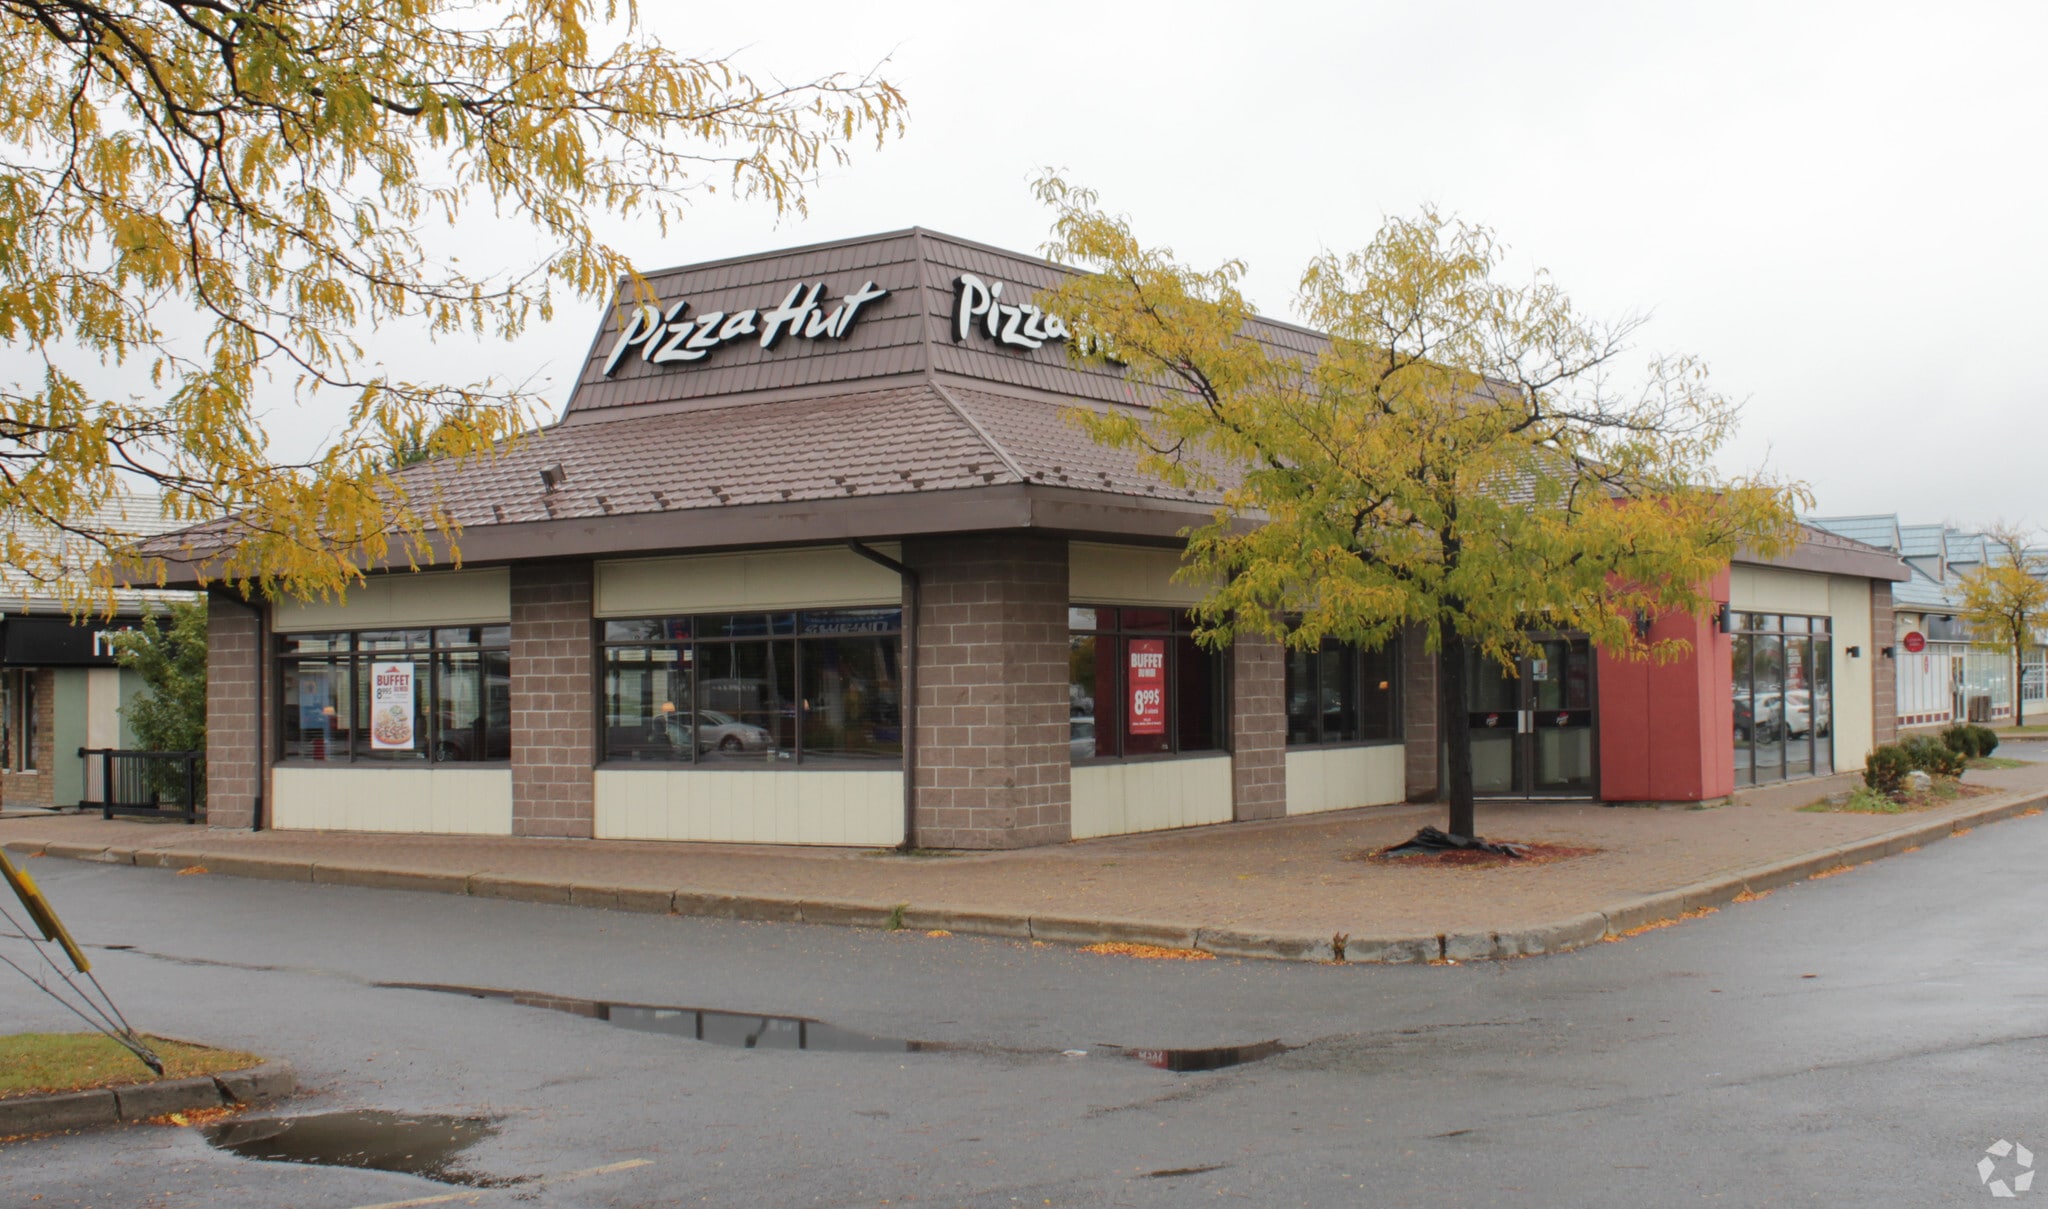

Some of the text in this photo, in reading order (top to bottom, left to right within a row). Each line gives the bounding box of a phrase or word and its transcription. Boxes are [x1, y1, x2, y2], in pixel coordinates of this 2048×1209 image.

[602, 280, 889, 377] Pizza Hut
[956, 273, 1071, 350] Pizza
[376, 674, 410, 686] BUFFET
[1131, 653, 1163, 668] BUFFET
